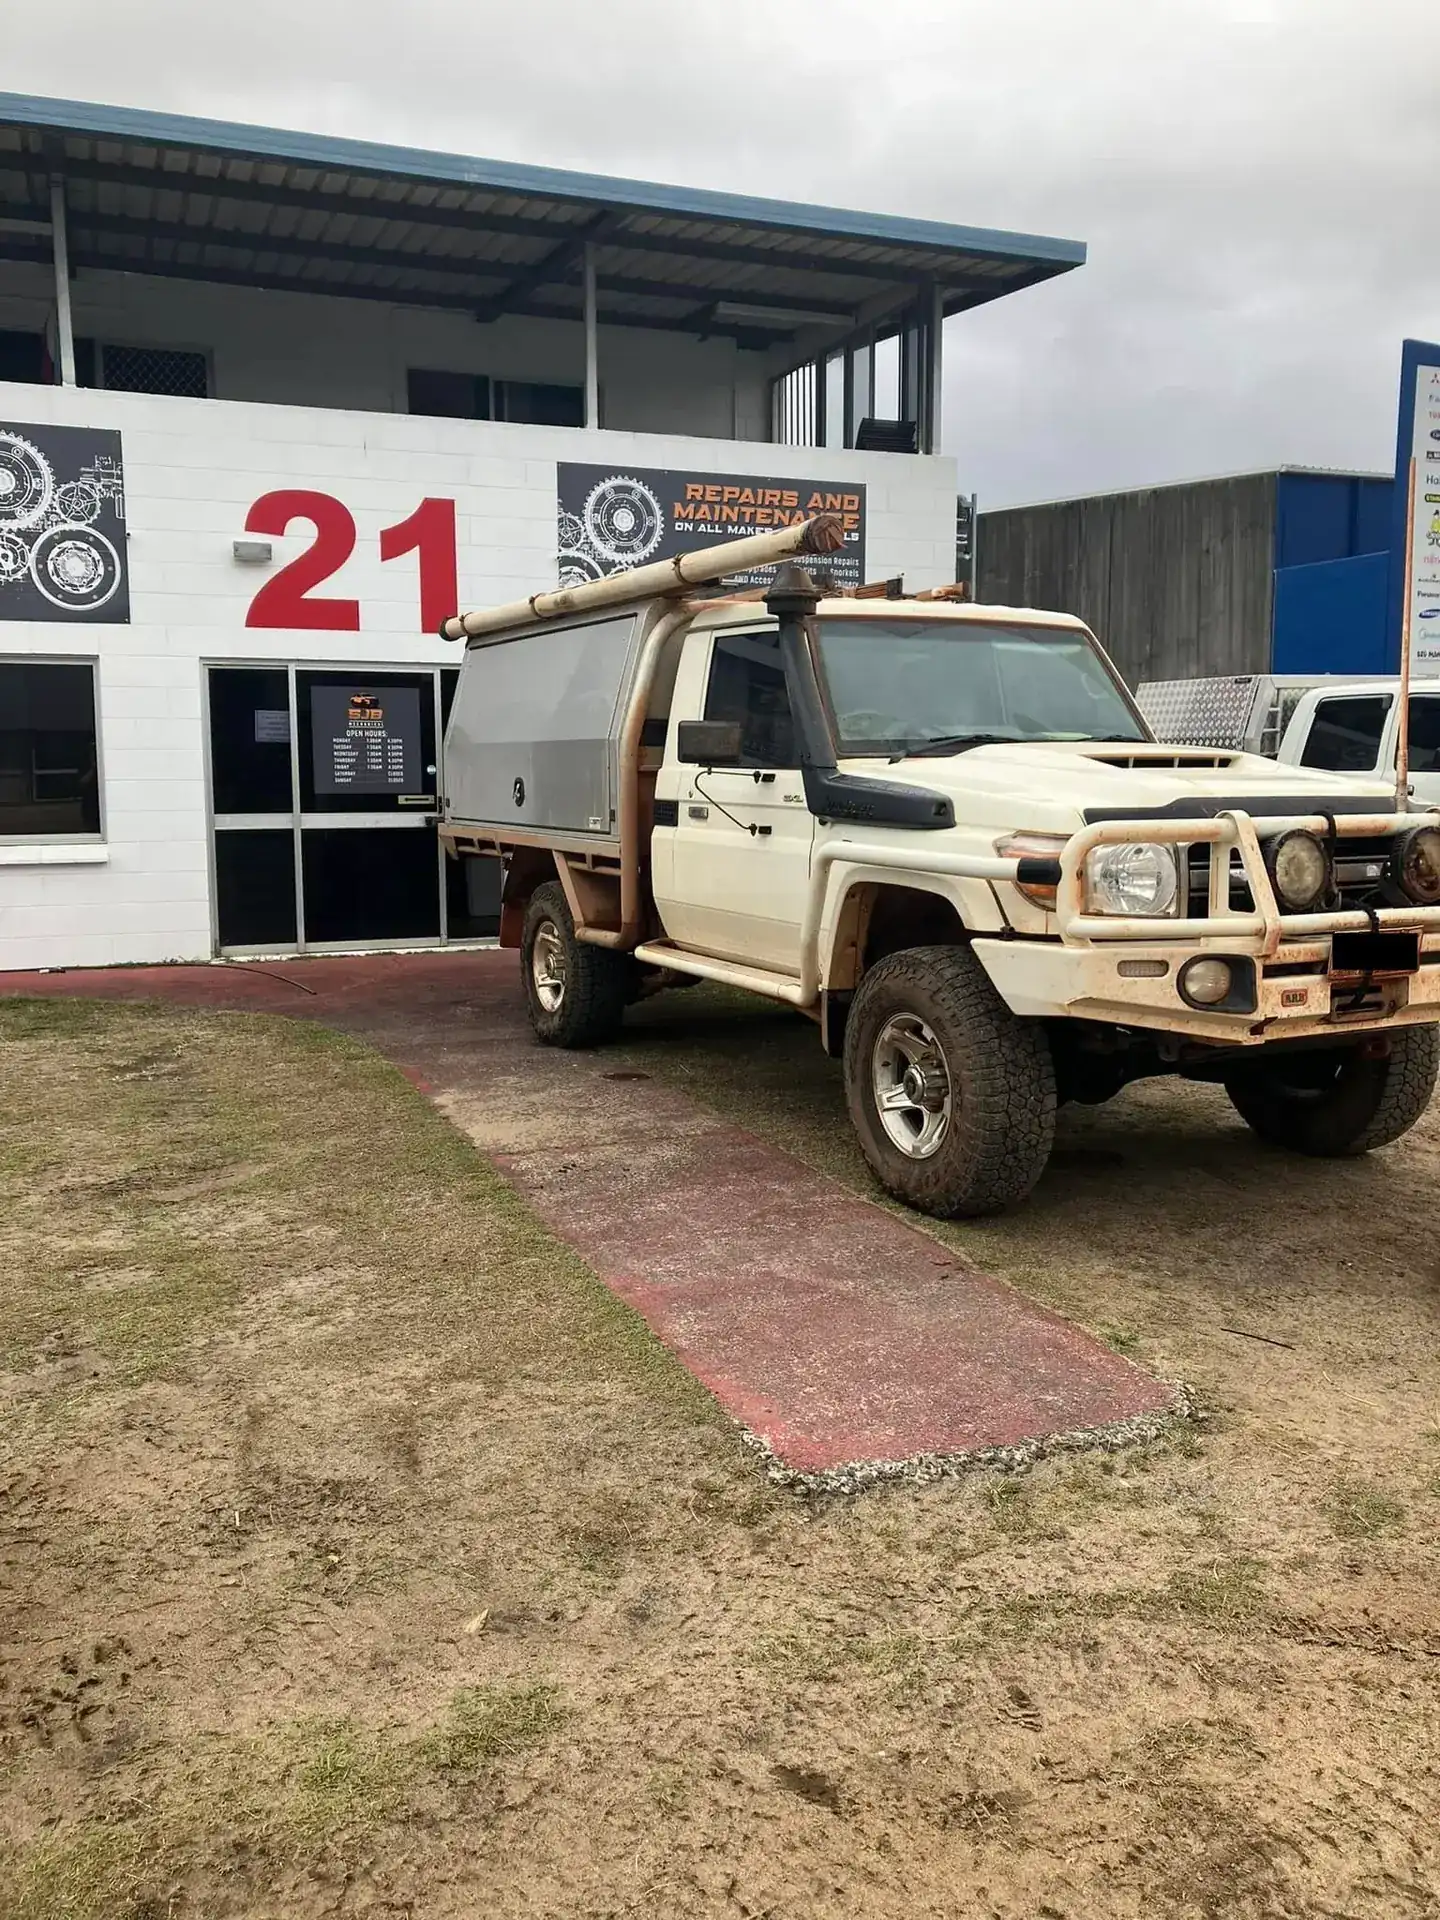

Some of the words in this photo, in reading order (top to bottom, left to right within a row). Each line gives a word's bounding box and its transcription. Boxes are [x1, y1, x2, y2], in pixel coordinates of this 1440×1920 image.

[685, 483, 799, 508] REPAIRS
[806, 492, 859, 511] AND
[673, 502, 860, 529] MAINTENAE
[674, 522, 694, 532] ON
[697, 523, 723, 533] ALL
[245, 489, 457, 633] 21
[833, 557, 859, 566] Repairs
[348, 709, 383, 720] SJB
[1285, 993, 1305, 1003] ARB
